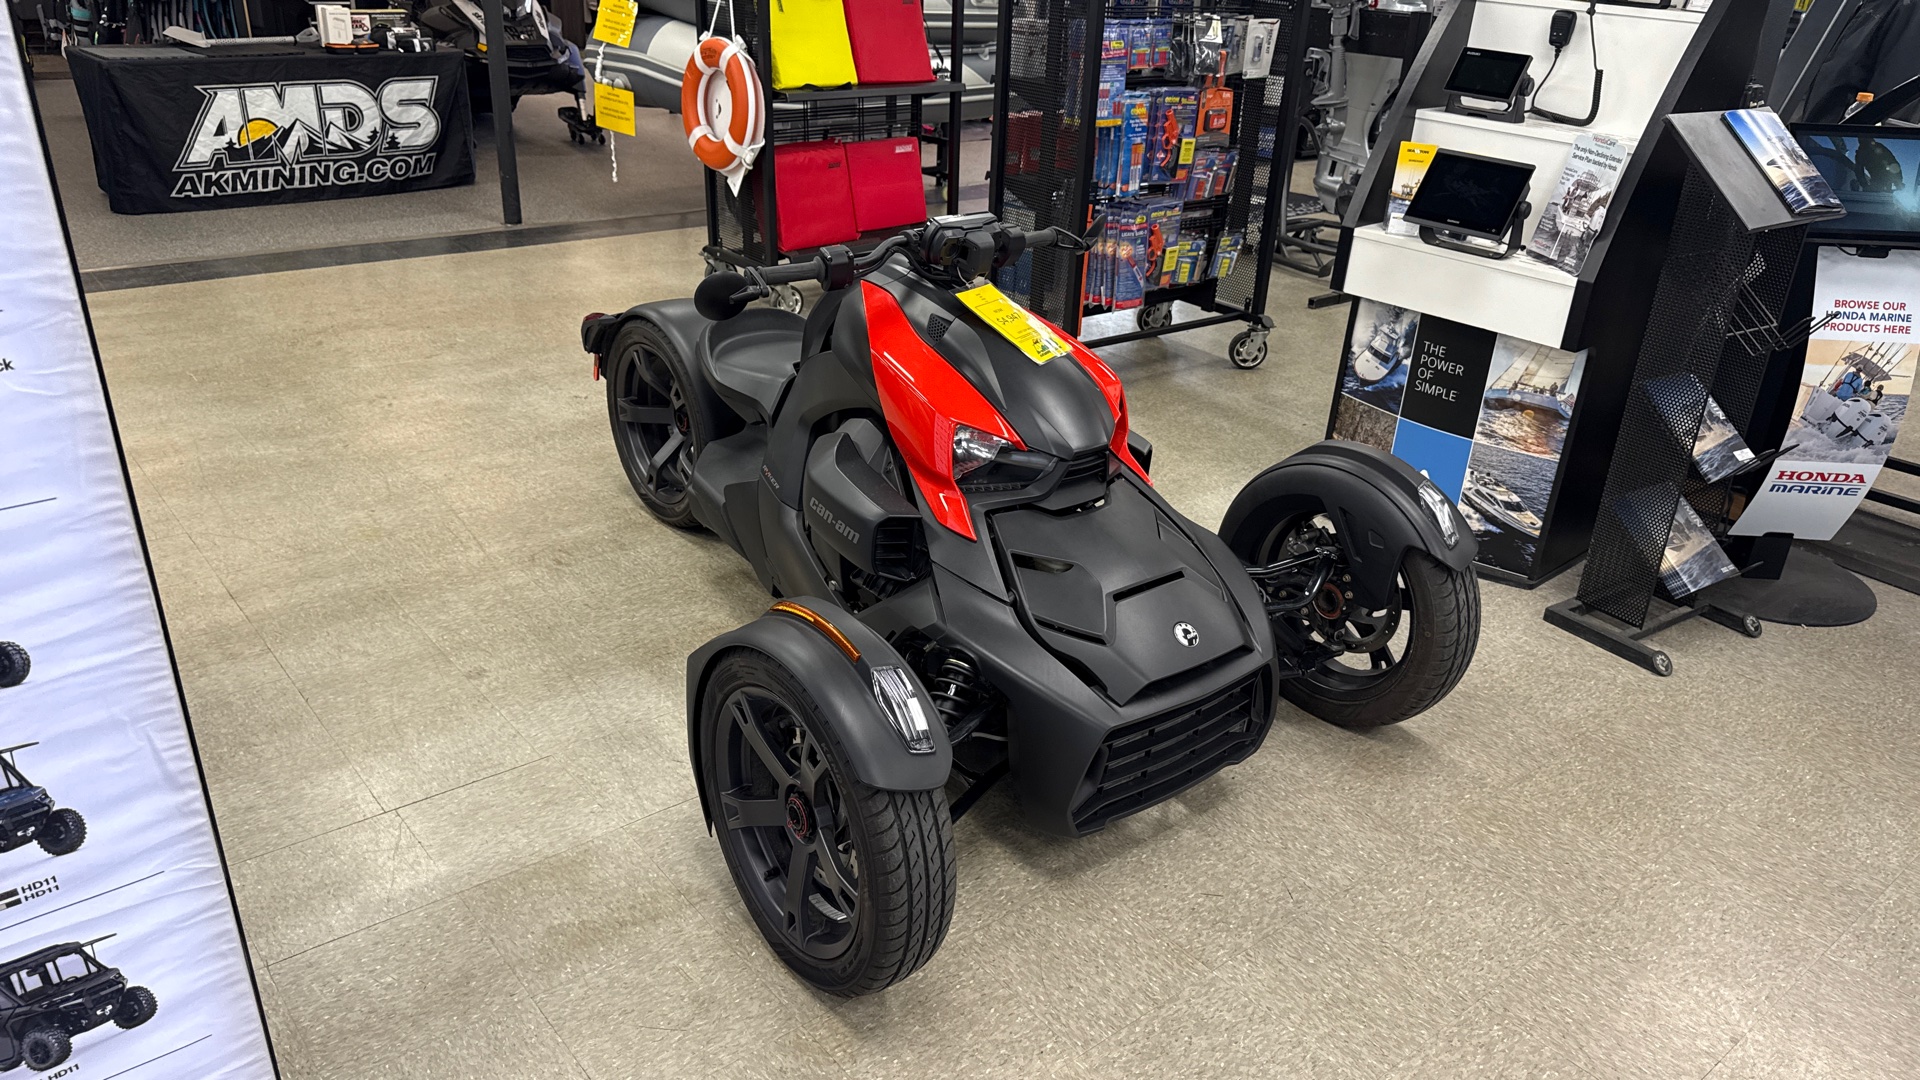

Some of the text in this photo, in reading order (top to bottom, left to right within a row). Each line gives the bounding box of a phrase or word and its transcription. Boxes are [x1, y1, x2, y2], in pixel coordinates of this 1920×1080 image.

[172, 75, 442, 172] AMDS
[170, 152, 437, 198] AKMINING.COM
[1834, 299, 1907, 311] BROWSE OUR
[1826, 310, 1913, 323] HONDA MARINE
[1823, 322, 1912, 335] PRODUCTS HERE
[1423, 340, 1447, 358] THE
[1417, 367, 1435, 380] OF
[1420, 353, 1465, 377] POWER
[1414, 379, 1458, 402] SIMPLE
[1775, 470, 1866, 484] HONDA
[1769, 483, 1861, 497] MARINE
[809, 496, 860, 544] can-am
[21, 875, 57, 894] HD11
[24, 884, 60, 901] HD11
[47, 1063, 80, 1080] HD11
